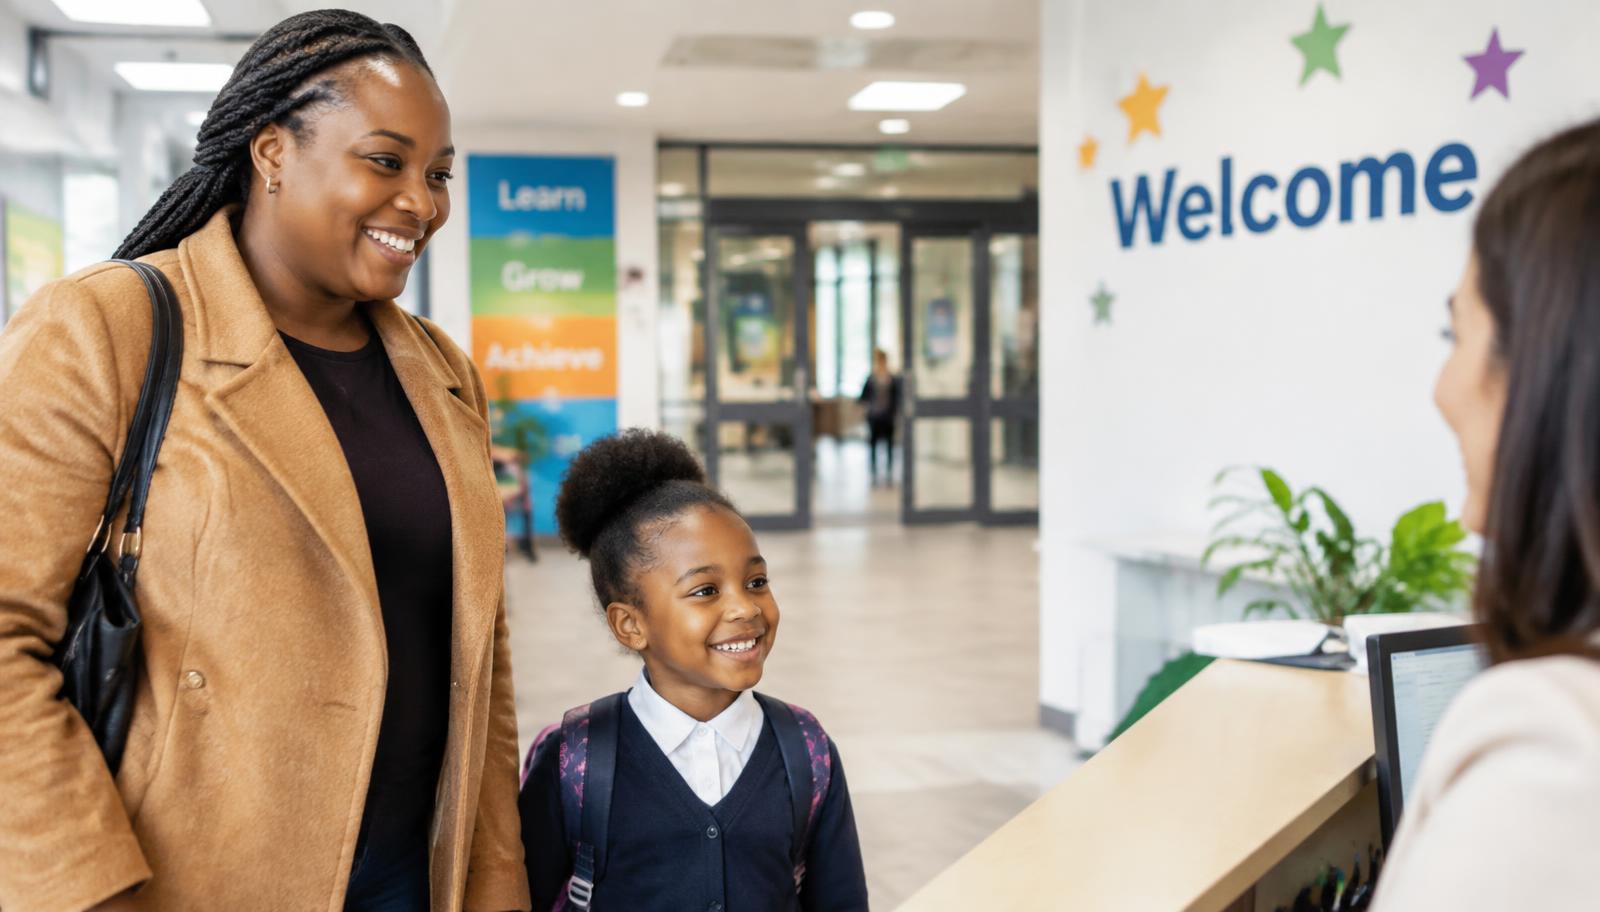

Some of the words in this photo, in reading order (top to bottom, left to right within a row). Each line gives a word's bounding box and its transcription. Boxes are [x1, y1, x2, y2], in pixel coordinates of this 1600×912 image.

[498, 180, 587, 211] Learn
[1110, 141, 1478, 250] Welcome
[502, 261, 584, 292] Grow
[486, 341, 604, 369] Achieve
